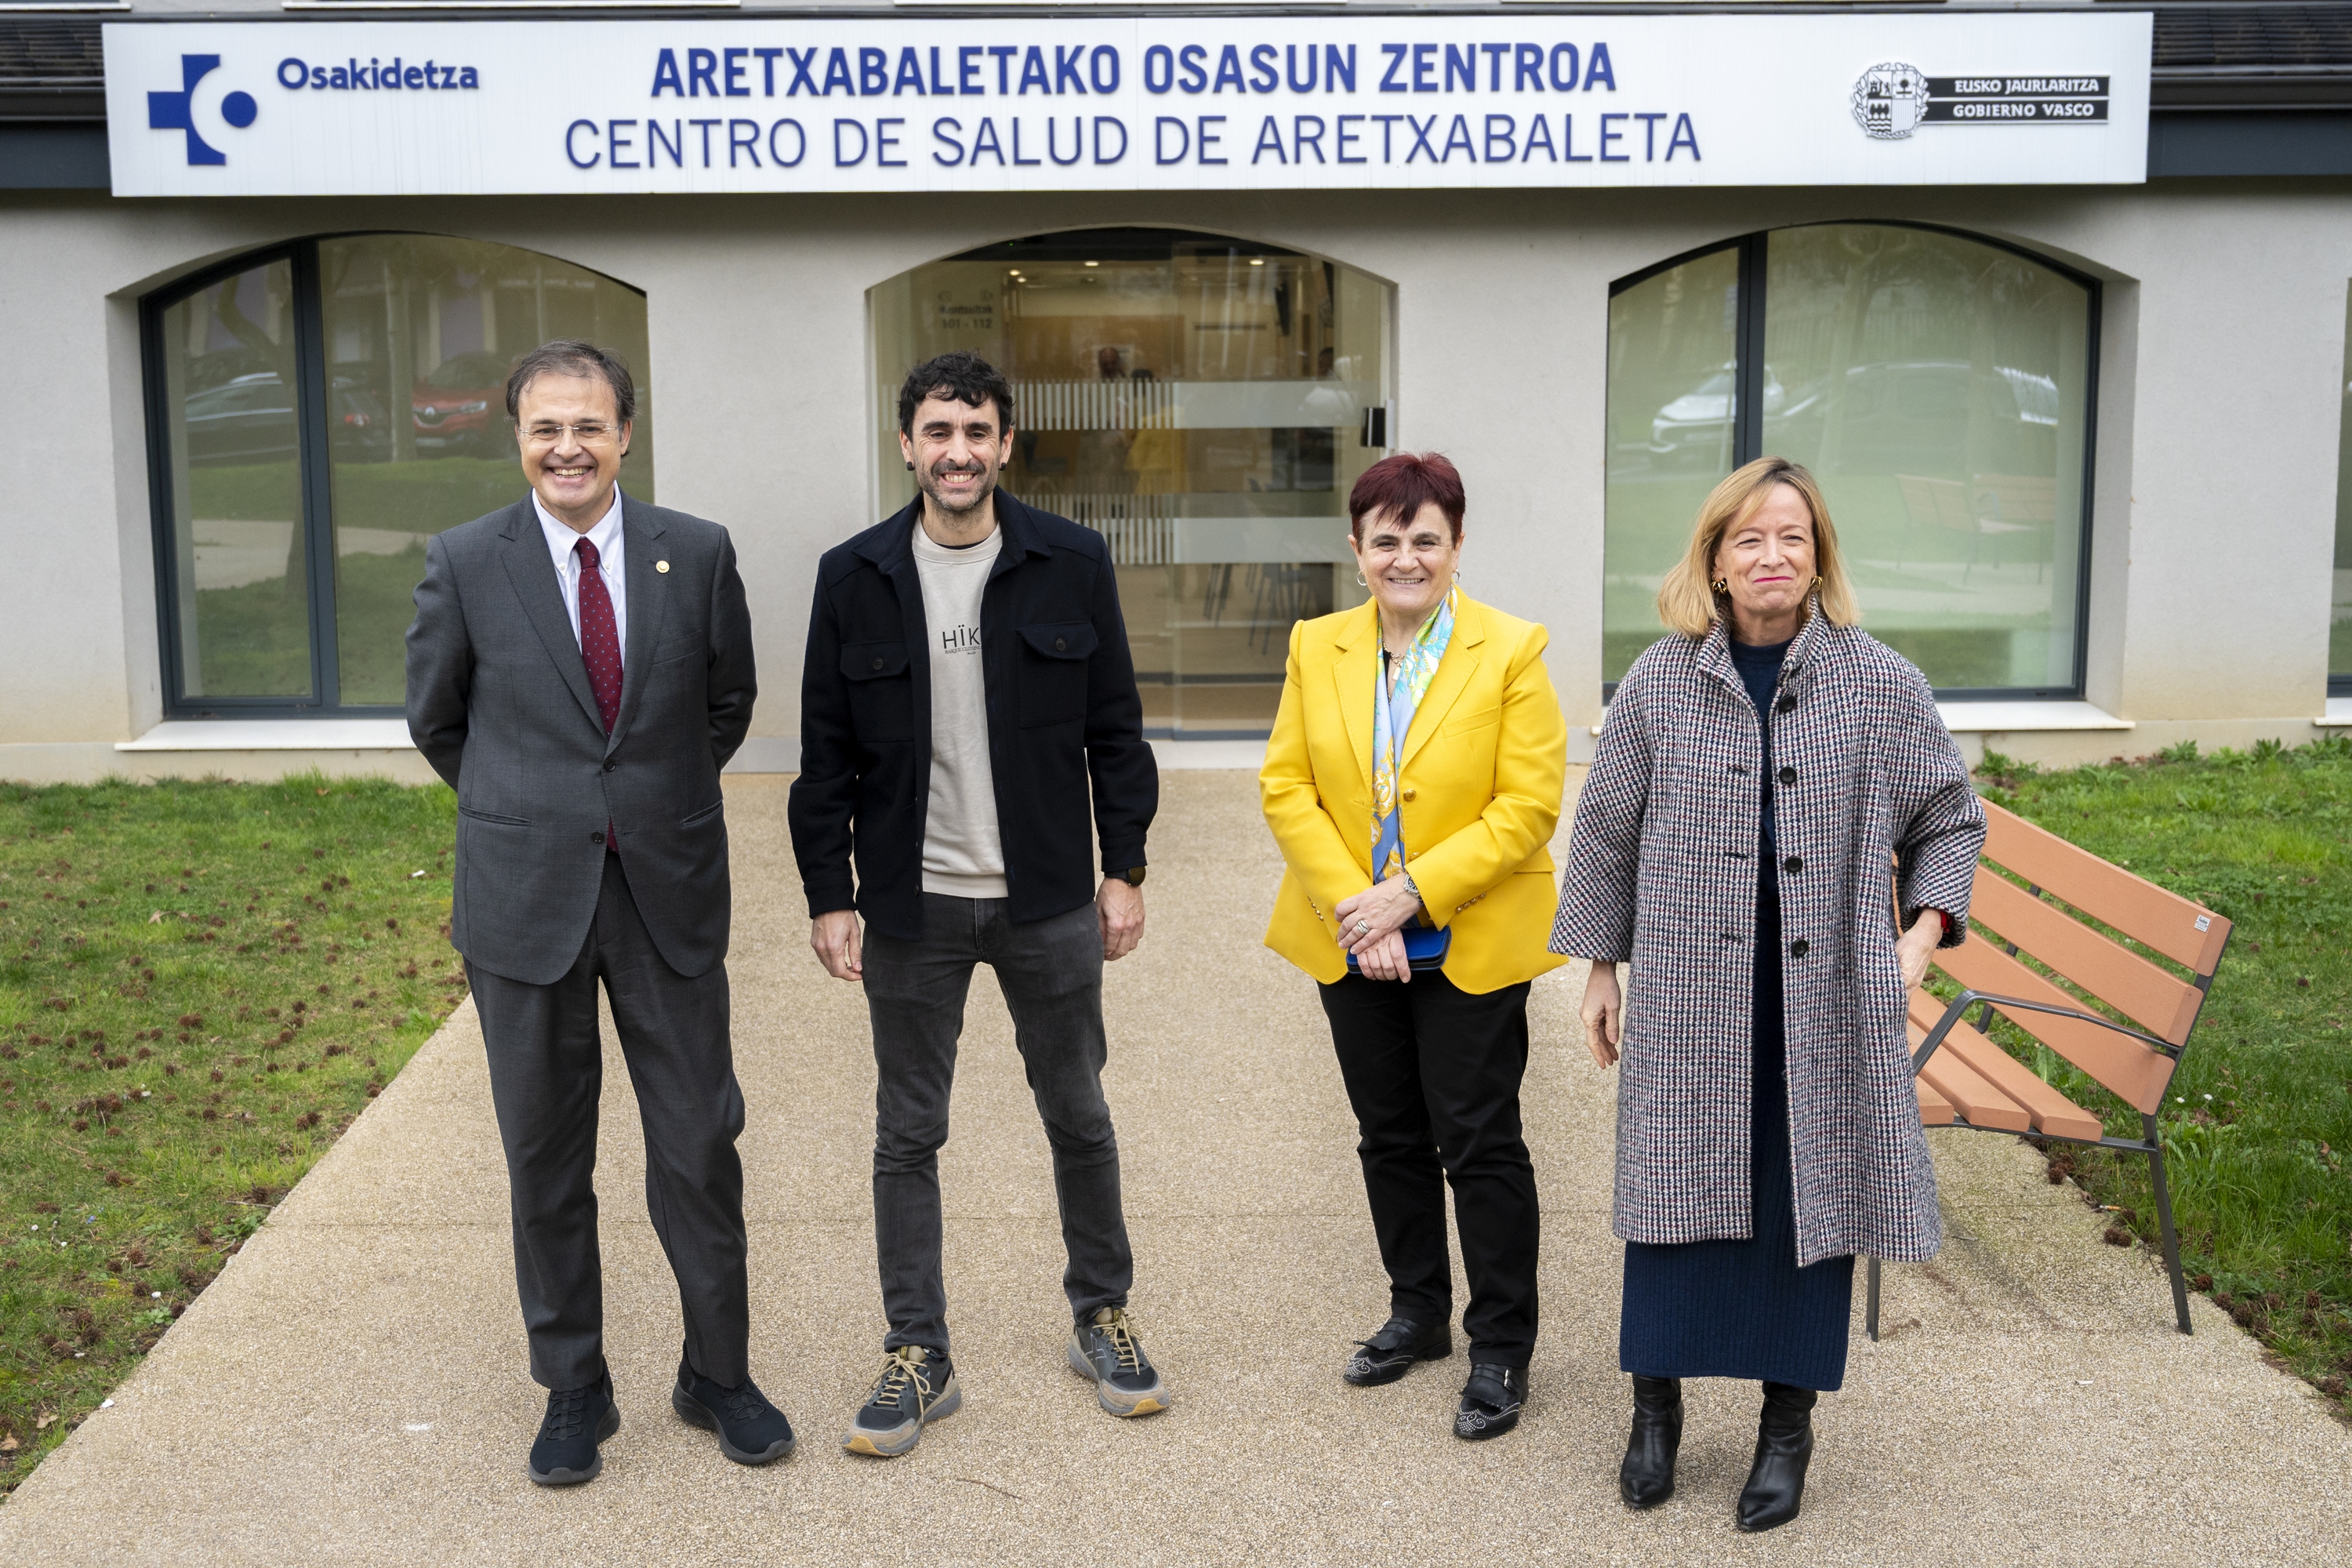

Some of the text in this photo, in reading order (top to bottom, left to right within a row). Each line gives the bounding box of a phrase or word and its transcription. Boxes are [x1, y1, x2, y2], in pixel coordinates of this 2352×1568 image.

[277, 57, 479, 91] Osakidetza
[651, 42, 1617, 97] ARETXABALETAKO OSASUN ZENTROA
[1954, 78, 2100, 95] EUSKO JAURLARITZA
[1952, 103, 2095, 118] GOBIERNO VASCO
[565, 112, 1701, 170] CENTRO DE SALUD DE ARETXABALETA
